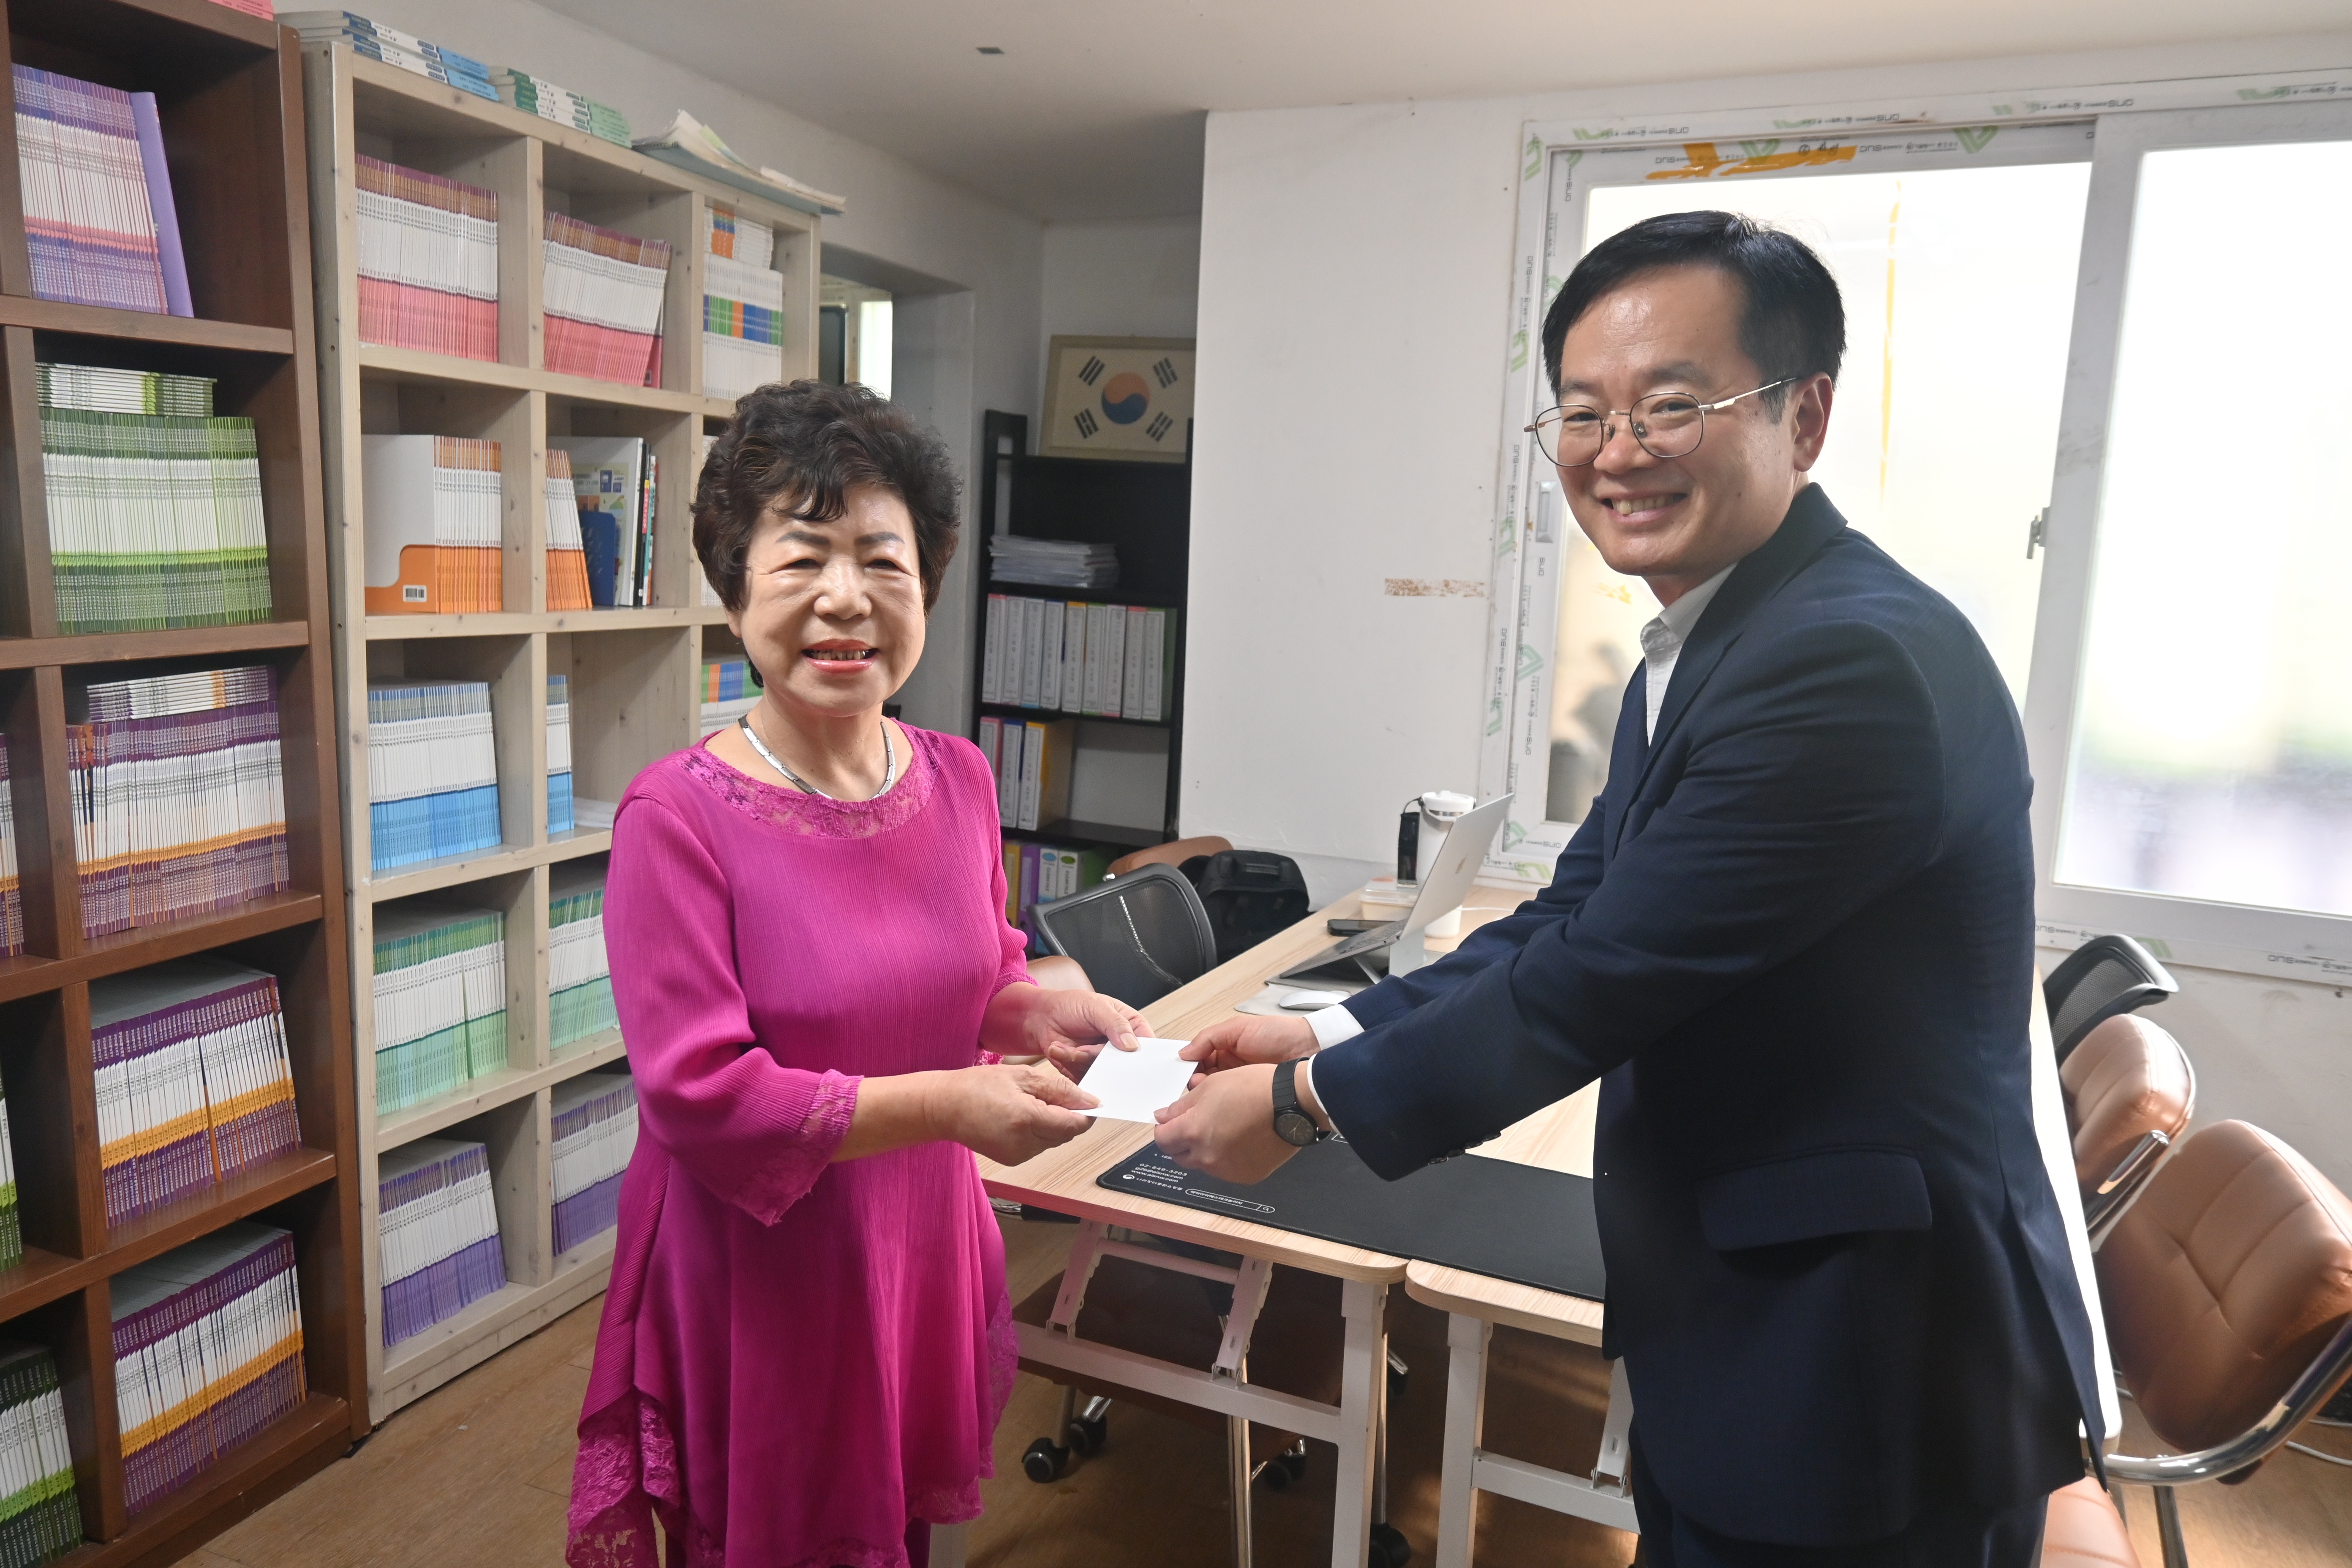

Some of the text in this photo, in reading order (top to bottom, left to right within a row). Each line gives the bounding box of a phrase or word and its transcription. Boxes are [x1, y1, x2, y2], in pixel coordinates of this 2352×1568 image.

[1135, 1167, 1184, 1180] g2b@aisnw.com
[1140, 1163, 1187, 1176] 02-549-3203
[1131, 1170, 1179, 1183] www.aisnw.com
